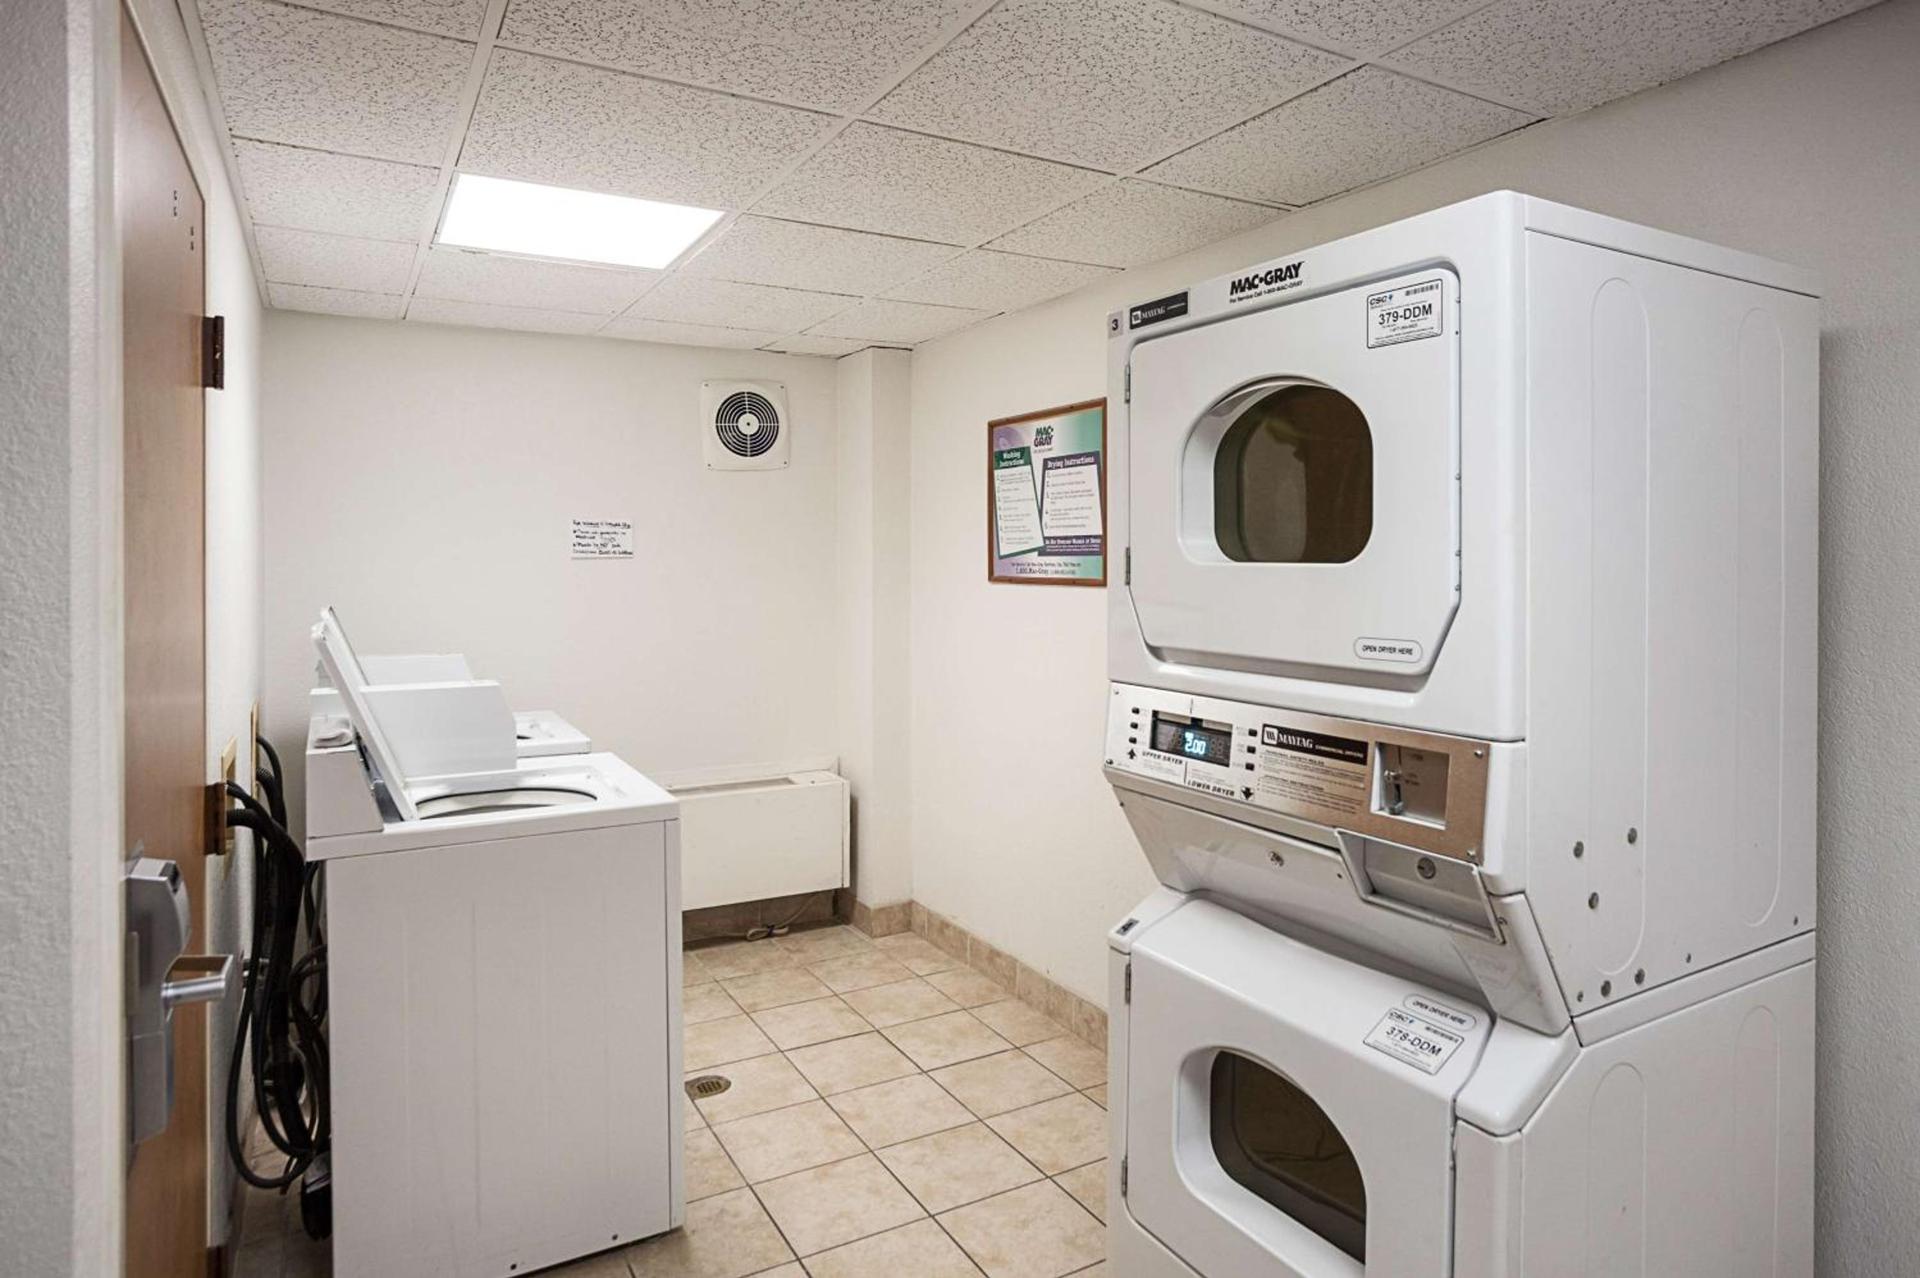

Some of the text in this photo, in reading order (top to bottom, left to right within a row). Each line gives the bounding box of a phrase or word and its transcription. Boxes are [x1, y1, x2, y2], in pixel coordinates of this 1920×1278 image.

[1378, 303, 1432, 325] 379-DDM
[1111, 318, 1119, 331] 3
[1278, 733, 1313, 749] MAYTAG
[1142, 750, 1183, 765] UPPER DRYER
[1187, 779, 1235, 797] LOWER DRYER
[1385, 1025, 1443, 1056] 378-DDM
